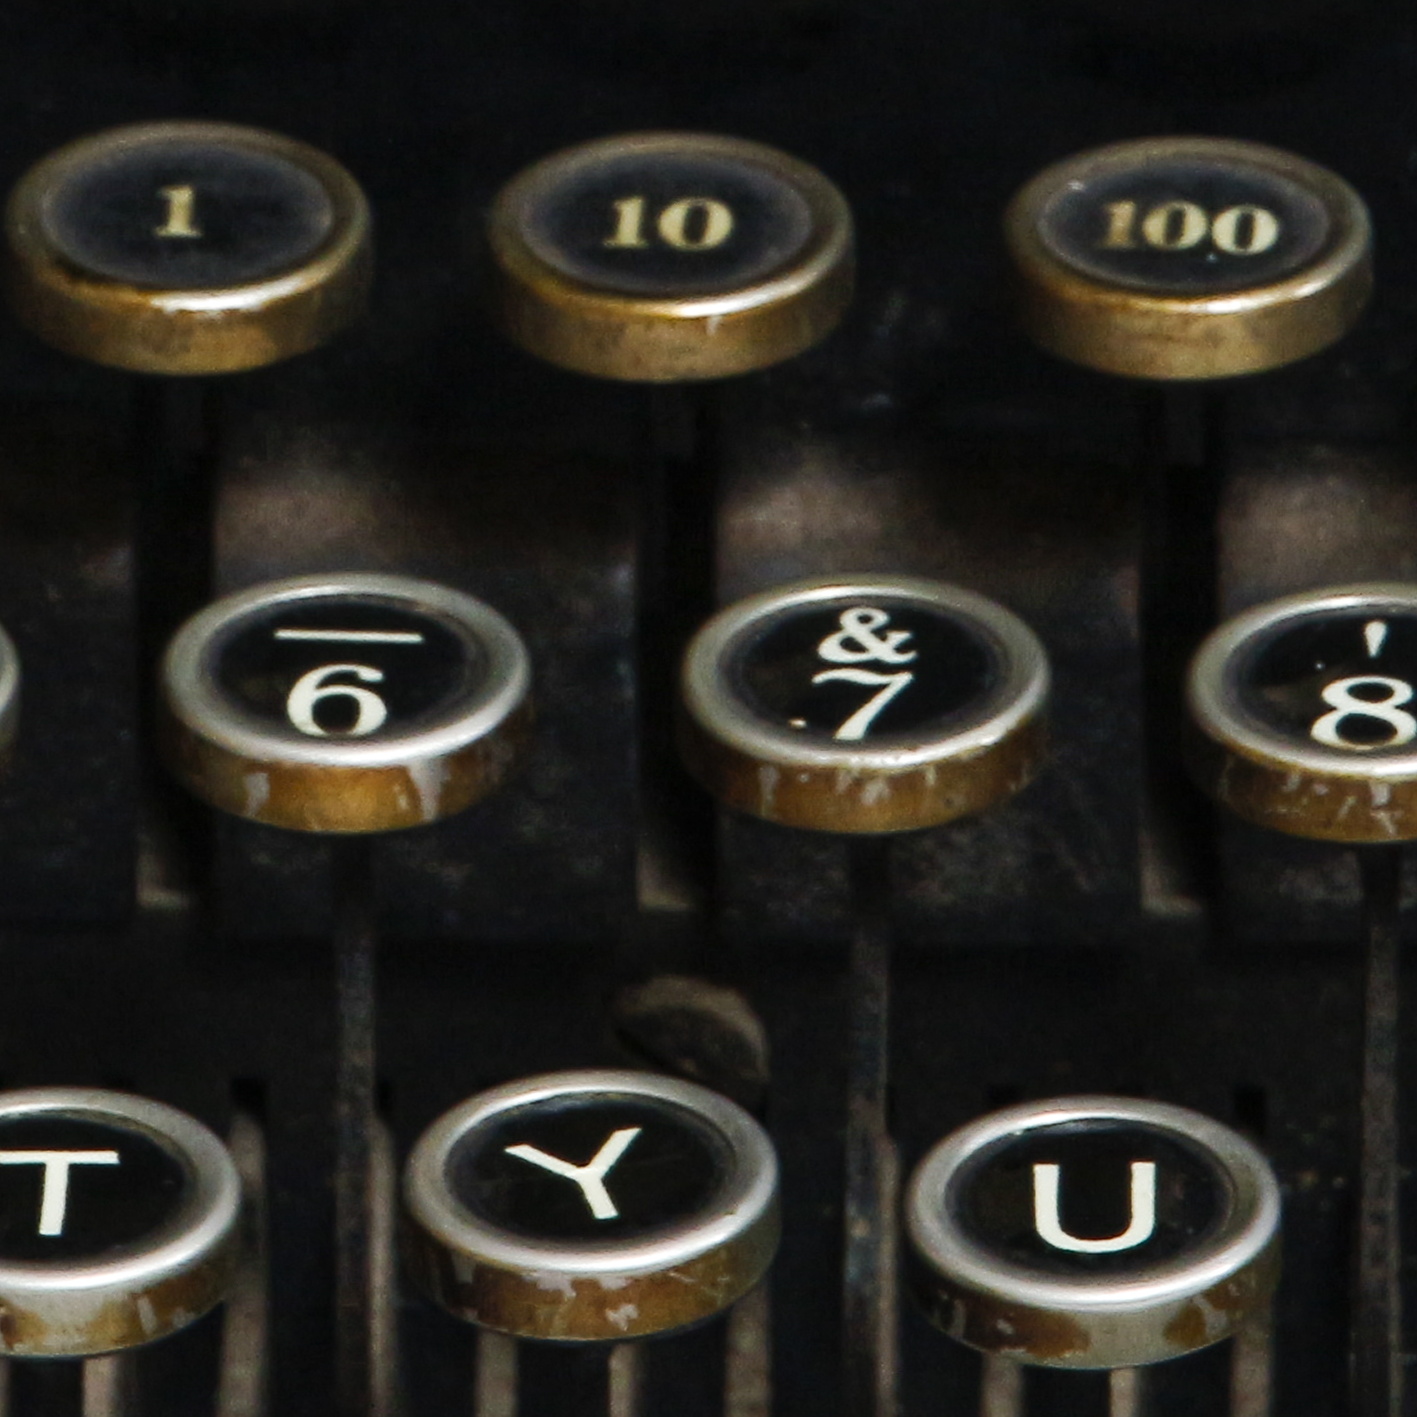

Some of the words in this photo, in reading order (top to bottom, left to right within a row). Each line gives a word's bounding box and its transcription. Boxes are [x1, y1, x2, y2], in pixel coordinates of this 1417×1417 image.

[154, 185, 203, 238] 1
[602, 196, 734, 251] 10
[1098, 199, 1279, 256] 100
[819, 608, 915, 663] &
[287, 665, 387, 735] 6
[813, 669, 912, 740] 7
[505, 1128, 640, 1219] Y
[1034, 1162, 1155, 1253] U
